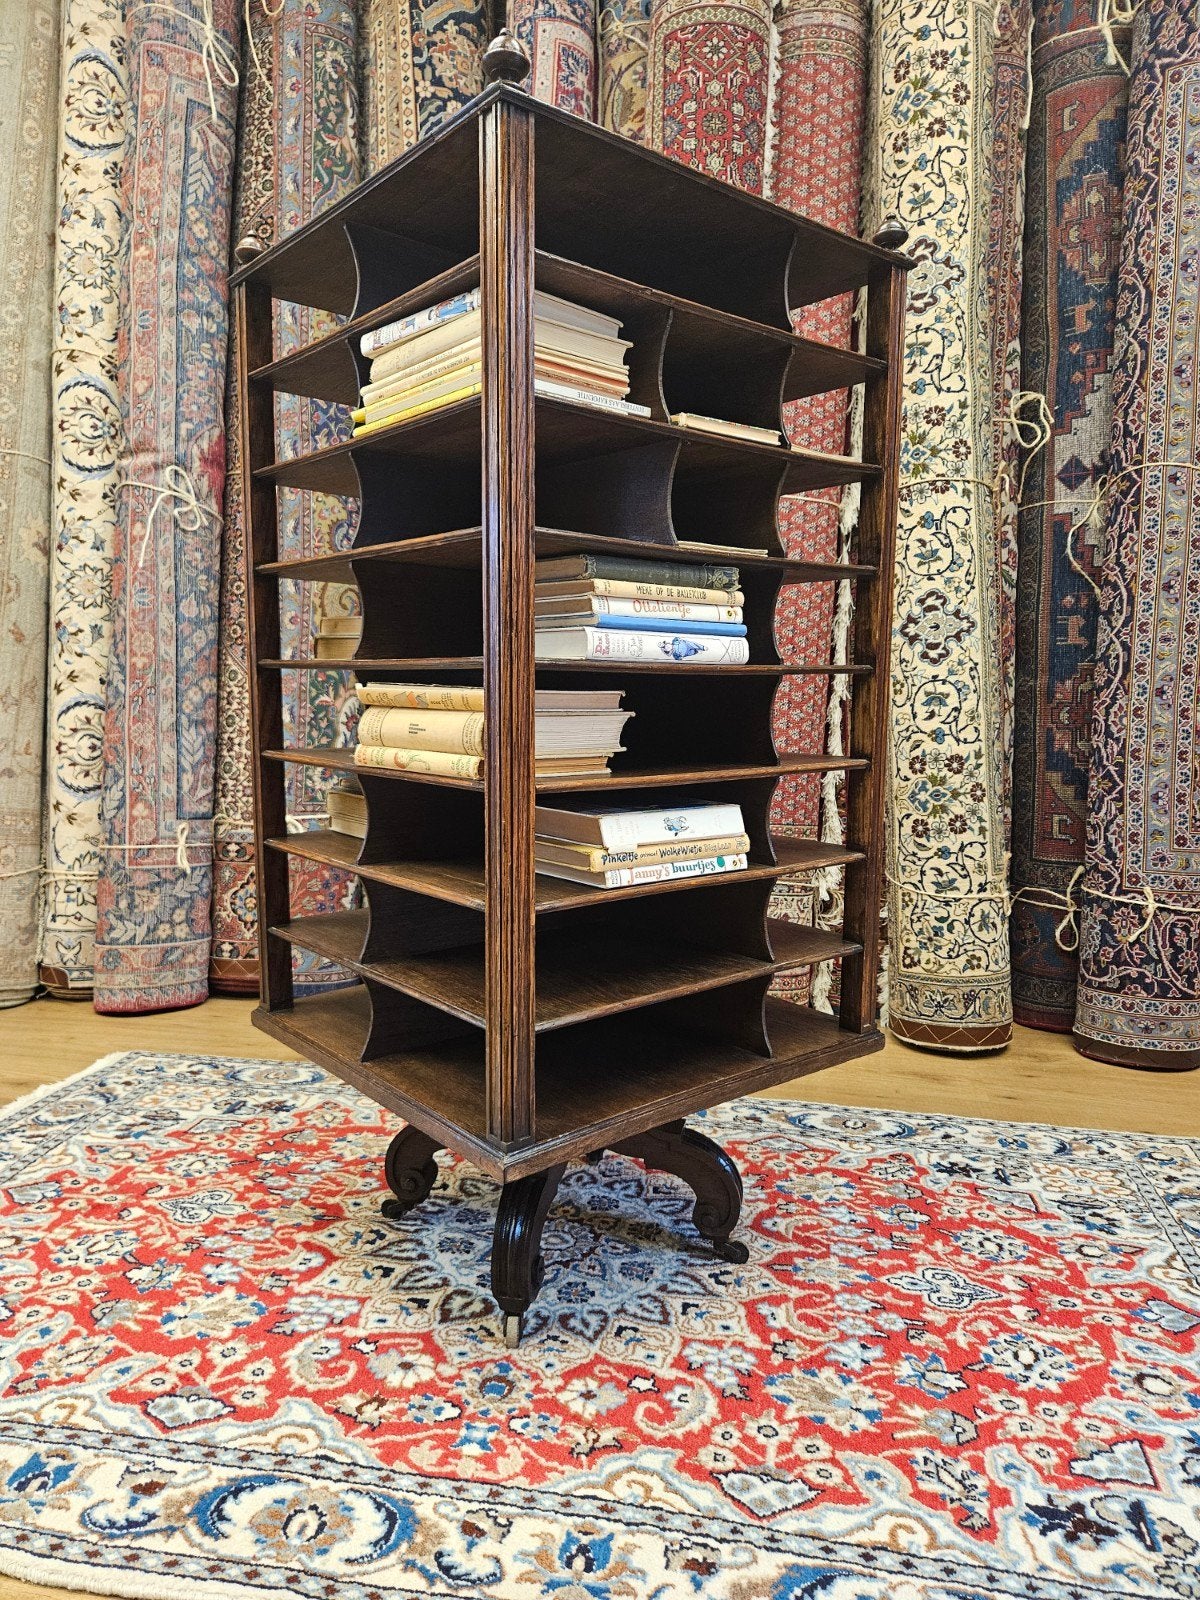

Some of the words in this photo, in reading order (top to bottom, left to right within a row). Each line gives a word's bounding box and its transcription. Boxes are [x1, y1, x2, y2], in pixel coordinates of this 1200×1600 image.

[656, 586, 664, 596] OP
[667, 587, 674, 597] DE
[633, 599, 691, 618] Ottelientje
[601, 851, 639, 866] Pinkeltje
[659, 845, 702, 858] WolkeWietje
[627, 865, 670, 883] Janny's
[671, 859, 716, 874] buurtjes
